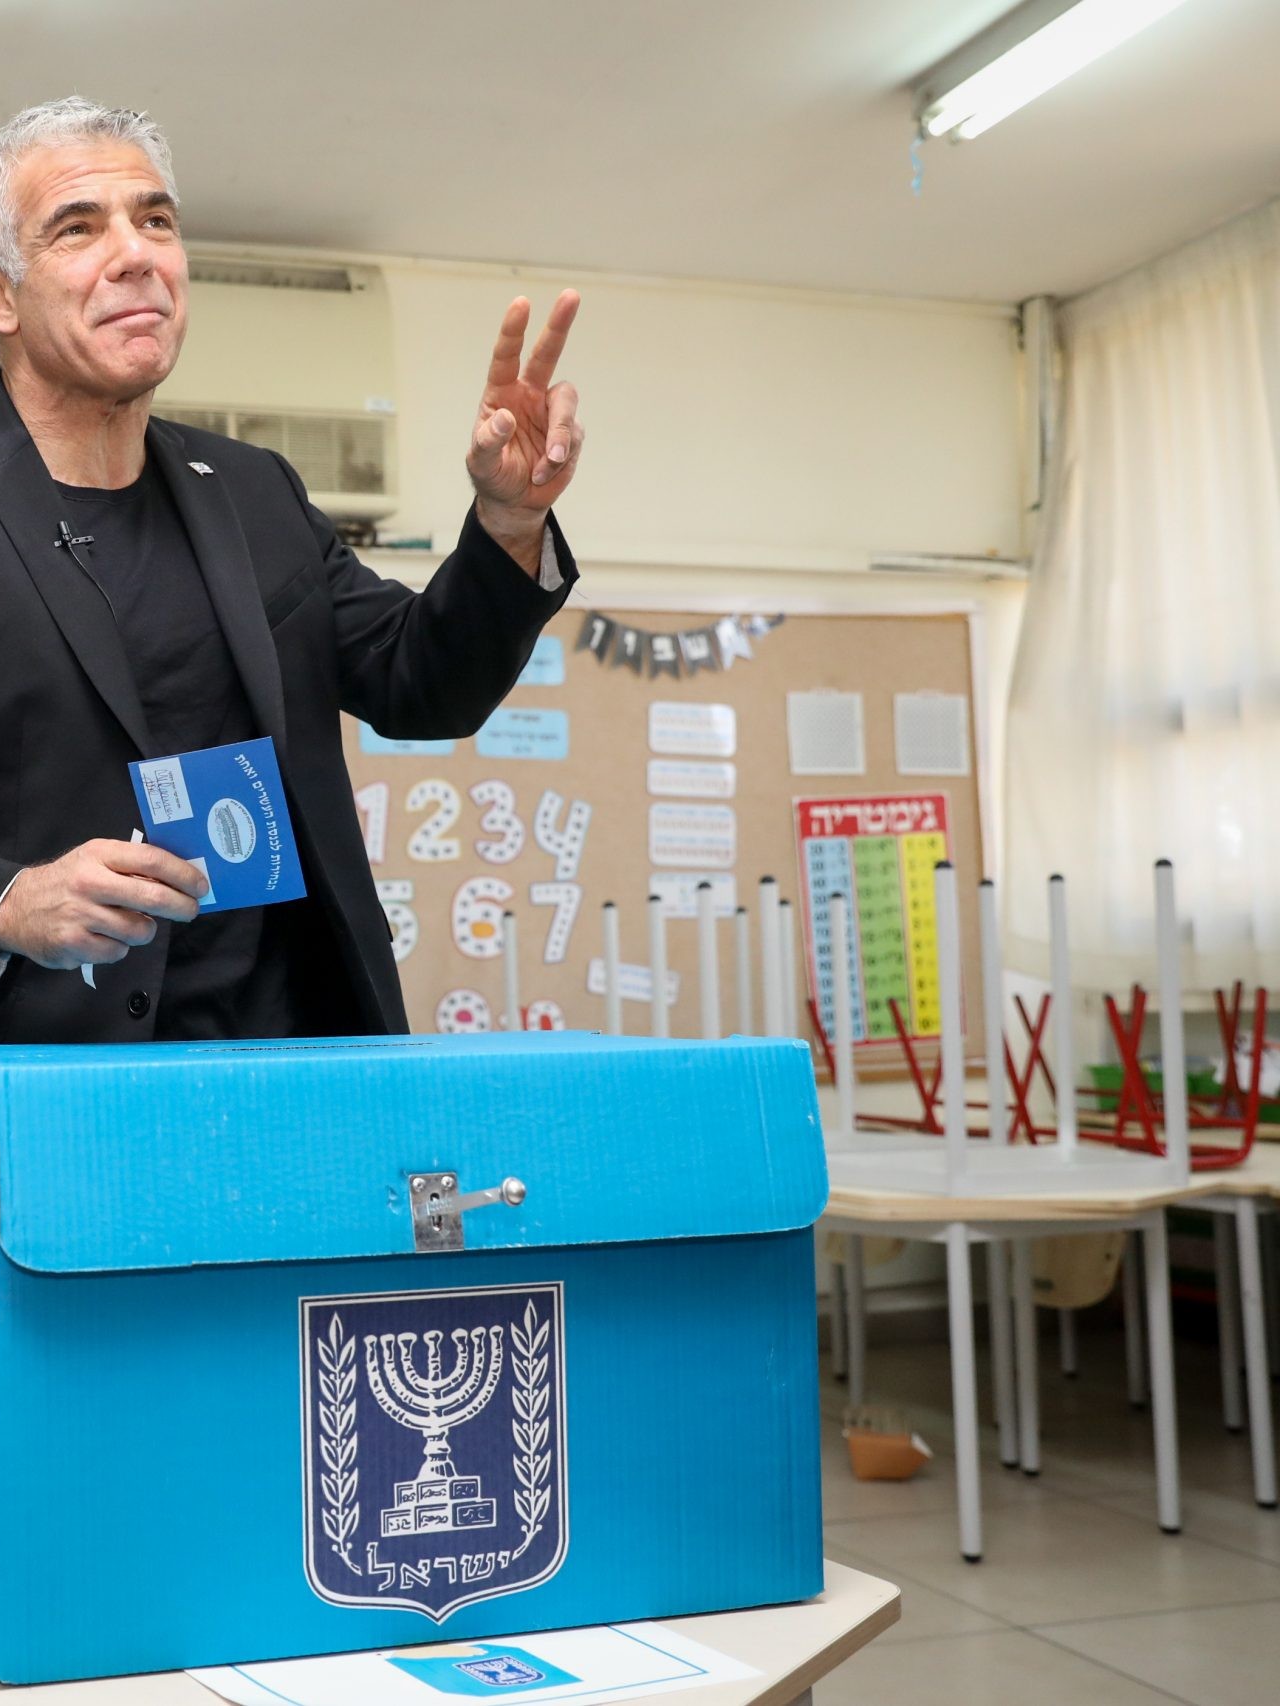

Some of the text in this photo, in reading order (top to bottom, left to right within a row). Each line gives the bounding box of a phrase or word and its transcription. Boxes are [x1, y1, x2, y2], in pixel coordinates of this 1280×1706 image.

[587, 618, 740, 664] שבון
[234, 753, 259, 779] ואחת
[251, 780, 274, 819] העשרים
[809, 800, 939, 837] גימטריה
[266, 821, 283, 851] לכנסת
[355, 781, 389, 864] 1
[405, 777, 462, 863] 2
[469, 778, 526, 865] 3
[534, 789, 593, 881] 4
[264, 854, 281, 891] הבחירות
[375, 879, 419, 963] 5
[452, 876, 514, 959] 6
[529, 881, 583, 964] 7
[365, 1541, 512, 1592] ישראל
